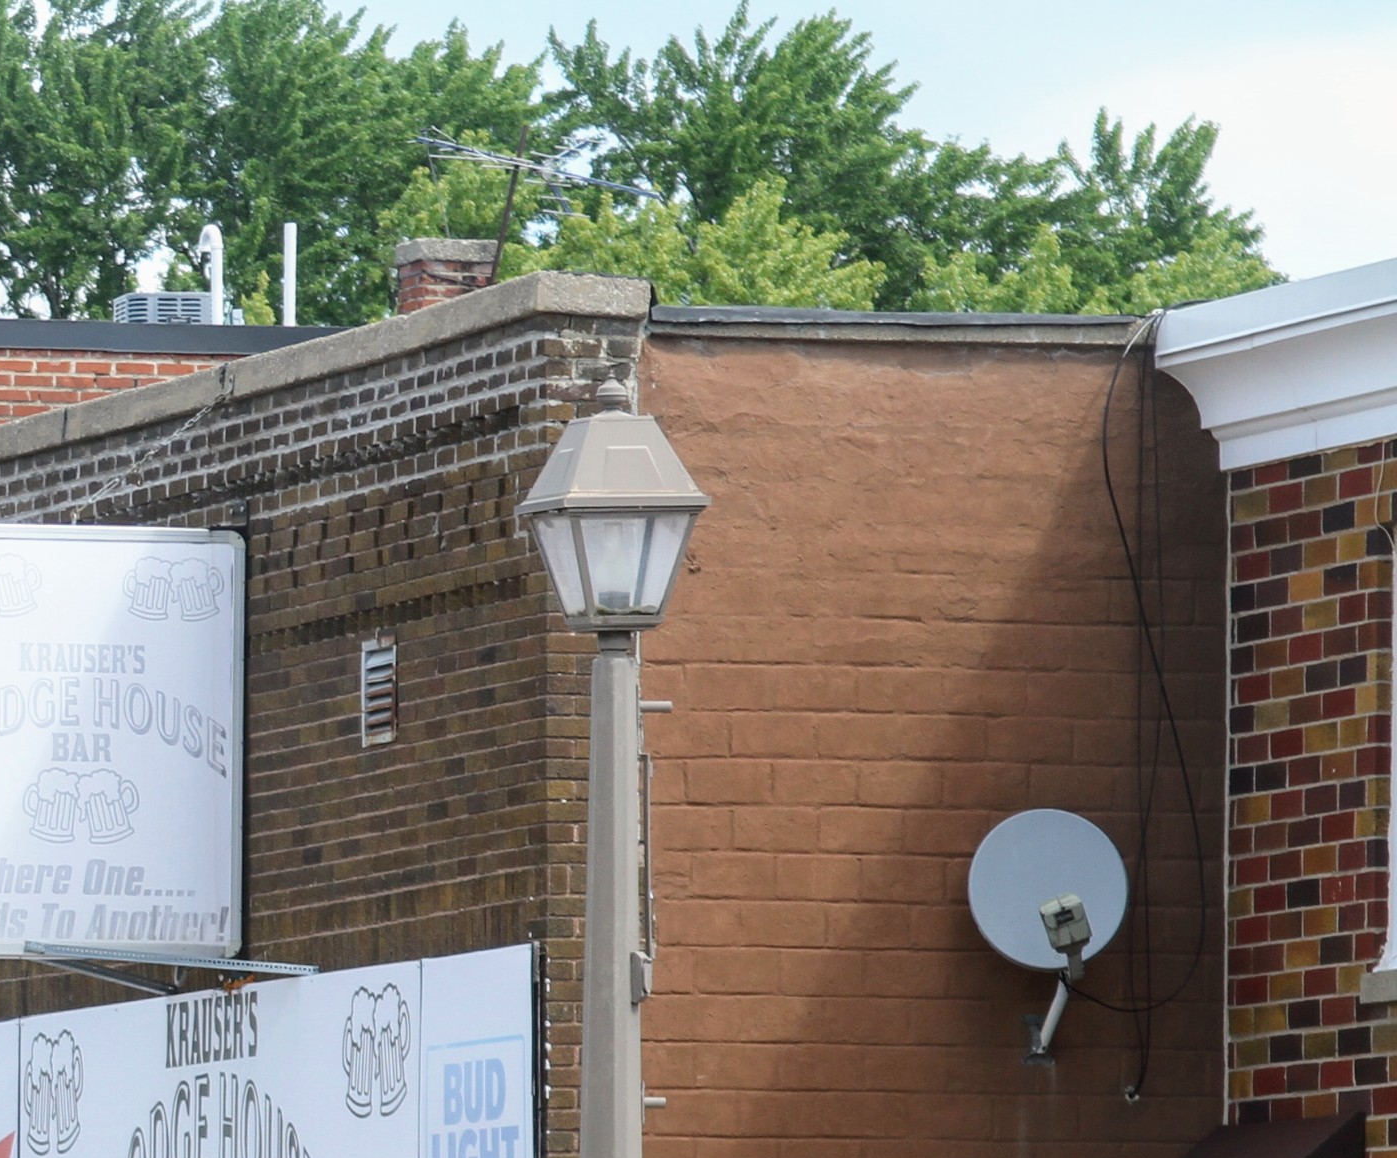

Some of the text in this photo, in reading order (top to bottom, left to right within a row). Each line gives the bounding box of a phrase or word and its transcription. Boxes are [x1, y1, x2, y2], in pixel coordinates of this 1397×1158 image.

[19, 643, 146, 674] KRAUSER'S
[51, 732, 112, 762] BAR
[92, 676, 228, 779] HOUSE
[41, 903, 76, 940] To
[84, 904, 229, 942] Another!
[165, 991, 259, 1069] KRAUSER'S
[443, 1057, 507, 1126] BUD
